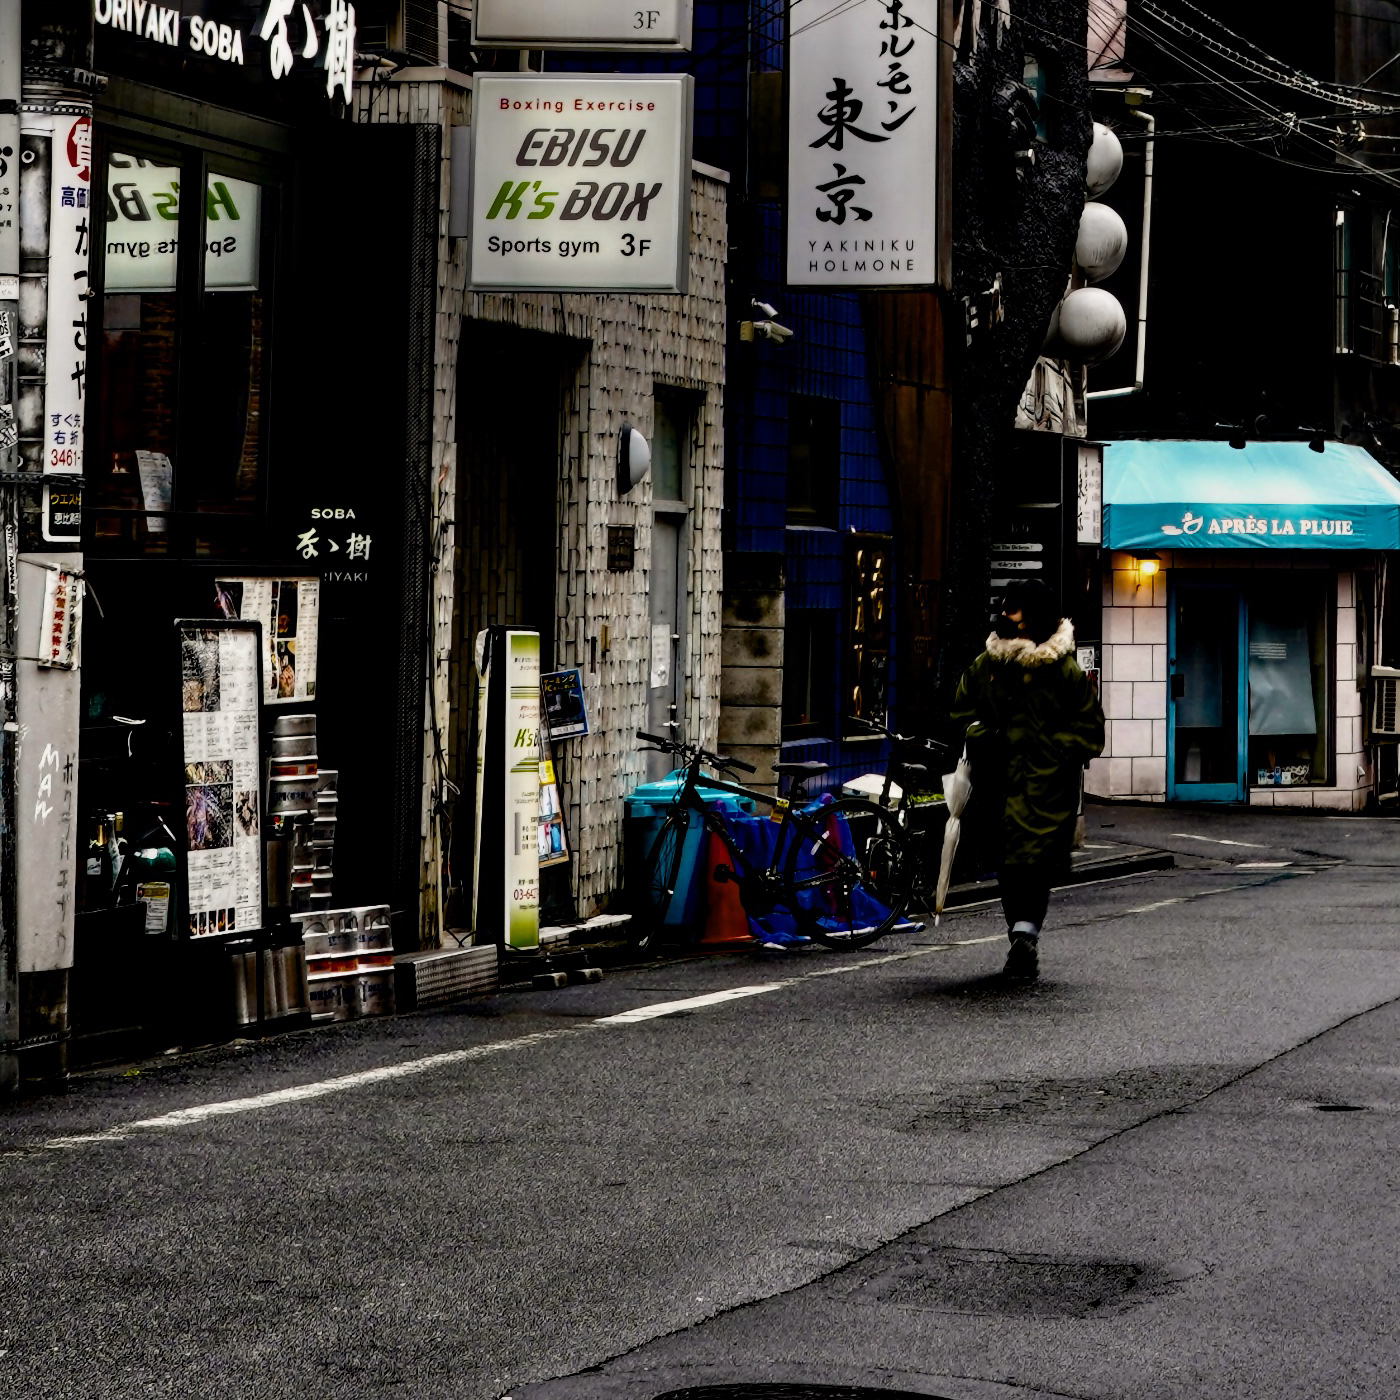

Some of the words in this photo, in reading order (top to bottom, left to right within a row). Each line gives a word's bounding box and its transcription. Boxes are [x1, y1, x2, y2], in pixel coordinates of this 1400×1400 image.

[632, 9, 661, 30] 3F
[188, 14, 245, 66] SOBA
[499, 98, 565, 114] Boxing
[573, 98, 657, 112] Exercise
[515, 128, 647, 168] EBISU
[807, 76, 892, 226] 東京
[486, 179, 560, 221] K's
[559, 181, 663, 221] BOX
[487, 236, 552, 257] Sports
[557, 238, 601, 257] gym
[619, 233, 652, 257] 3F
[808, 239, 915, 252] YAKINIKU
[808, 259, 915, 272] HOLMONE
[50, 448, 83, 467] 3461-
[311, 508, 356, 520] SOBA
[1207, 515, 1268, 535] APRÈS
[1270, 518, 1297, 536] LA
[1299, 518, 1354, 536] PLUIE
